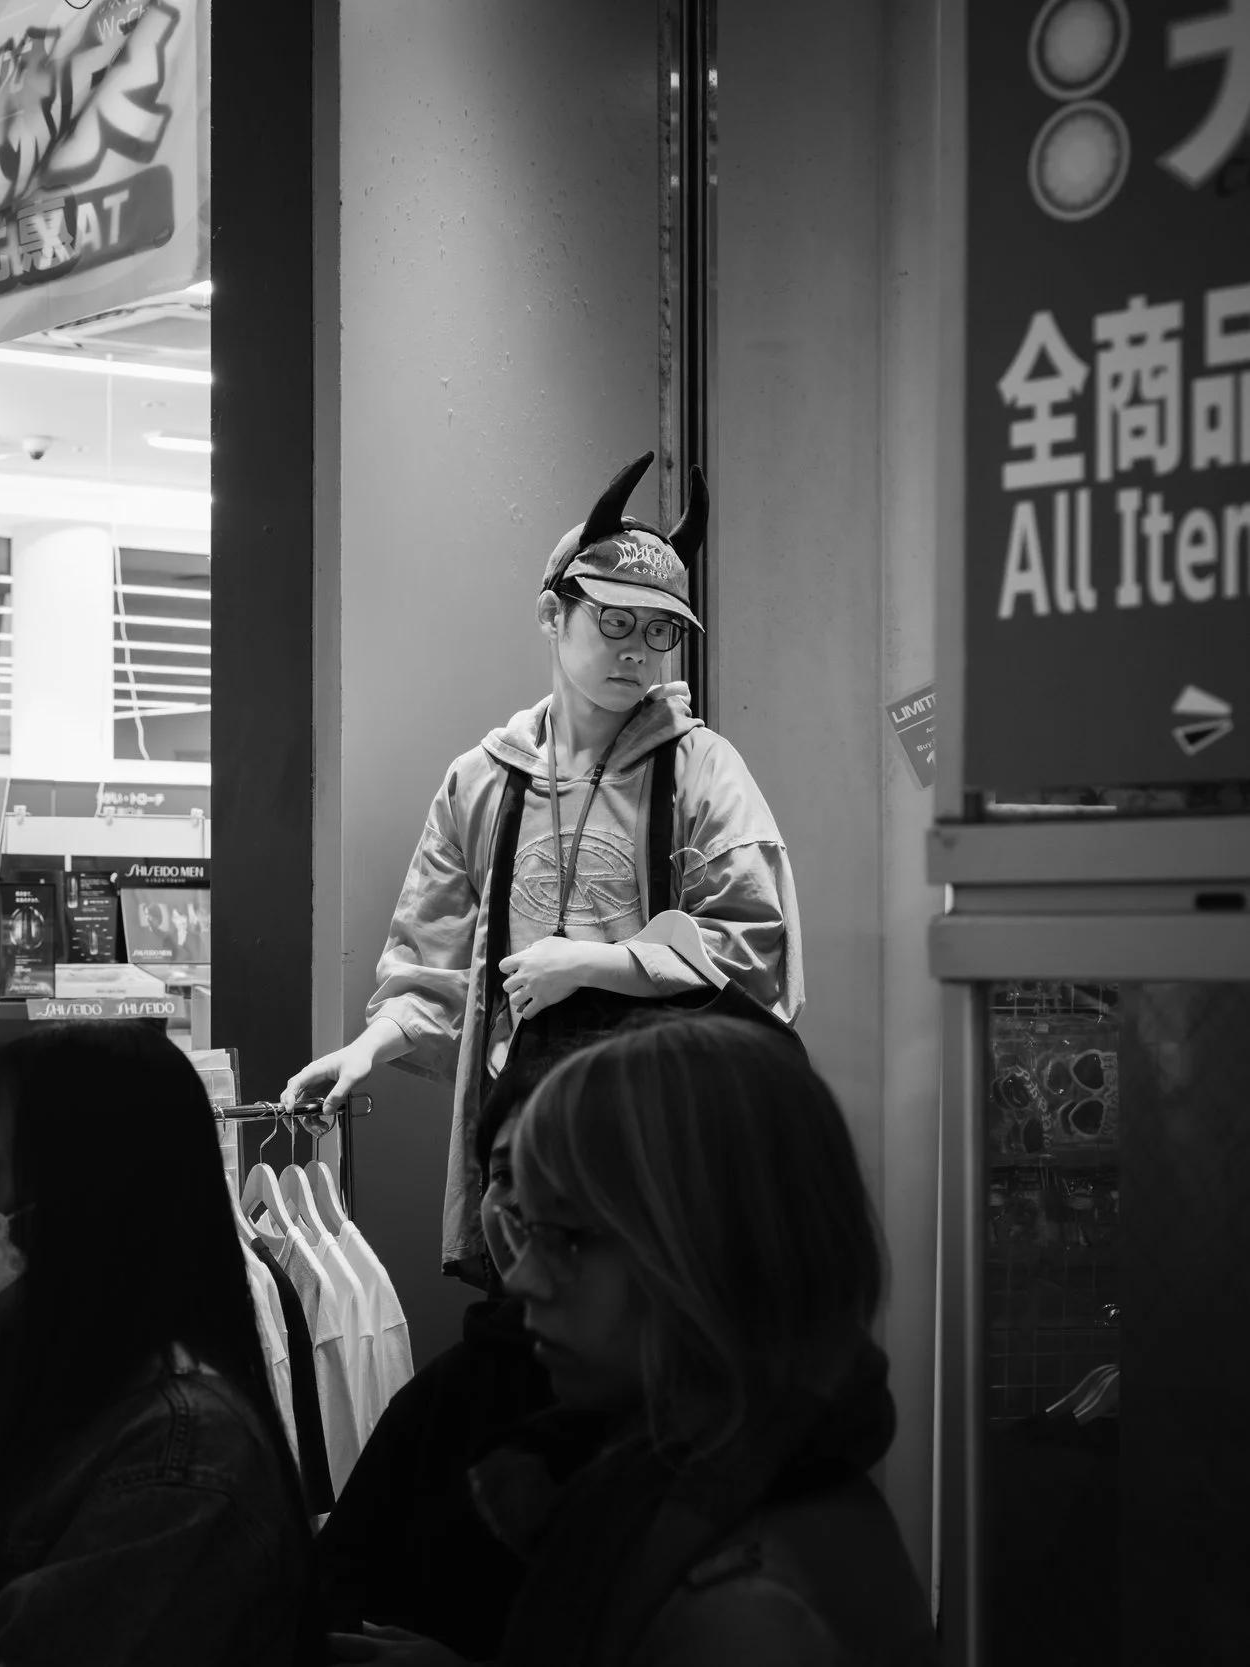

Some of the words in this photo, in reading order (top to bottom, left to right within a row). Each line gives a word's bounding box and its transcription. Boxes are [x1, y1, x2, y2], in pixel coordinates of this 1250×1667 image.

[998, 488, 1097, 619] All
[125, 864, 181, 877] SHISEIDO
[181, 866, 204, 878] MEN
[39, 1002, 102, 1017] SHISEIDO
[113, 1001, 175, 1016] SHISEIDO
